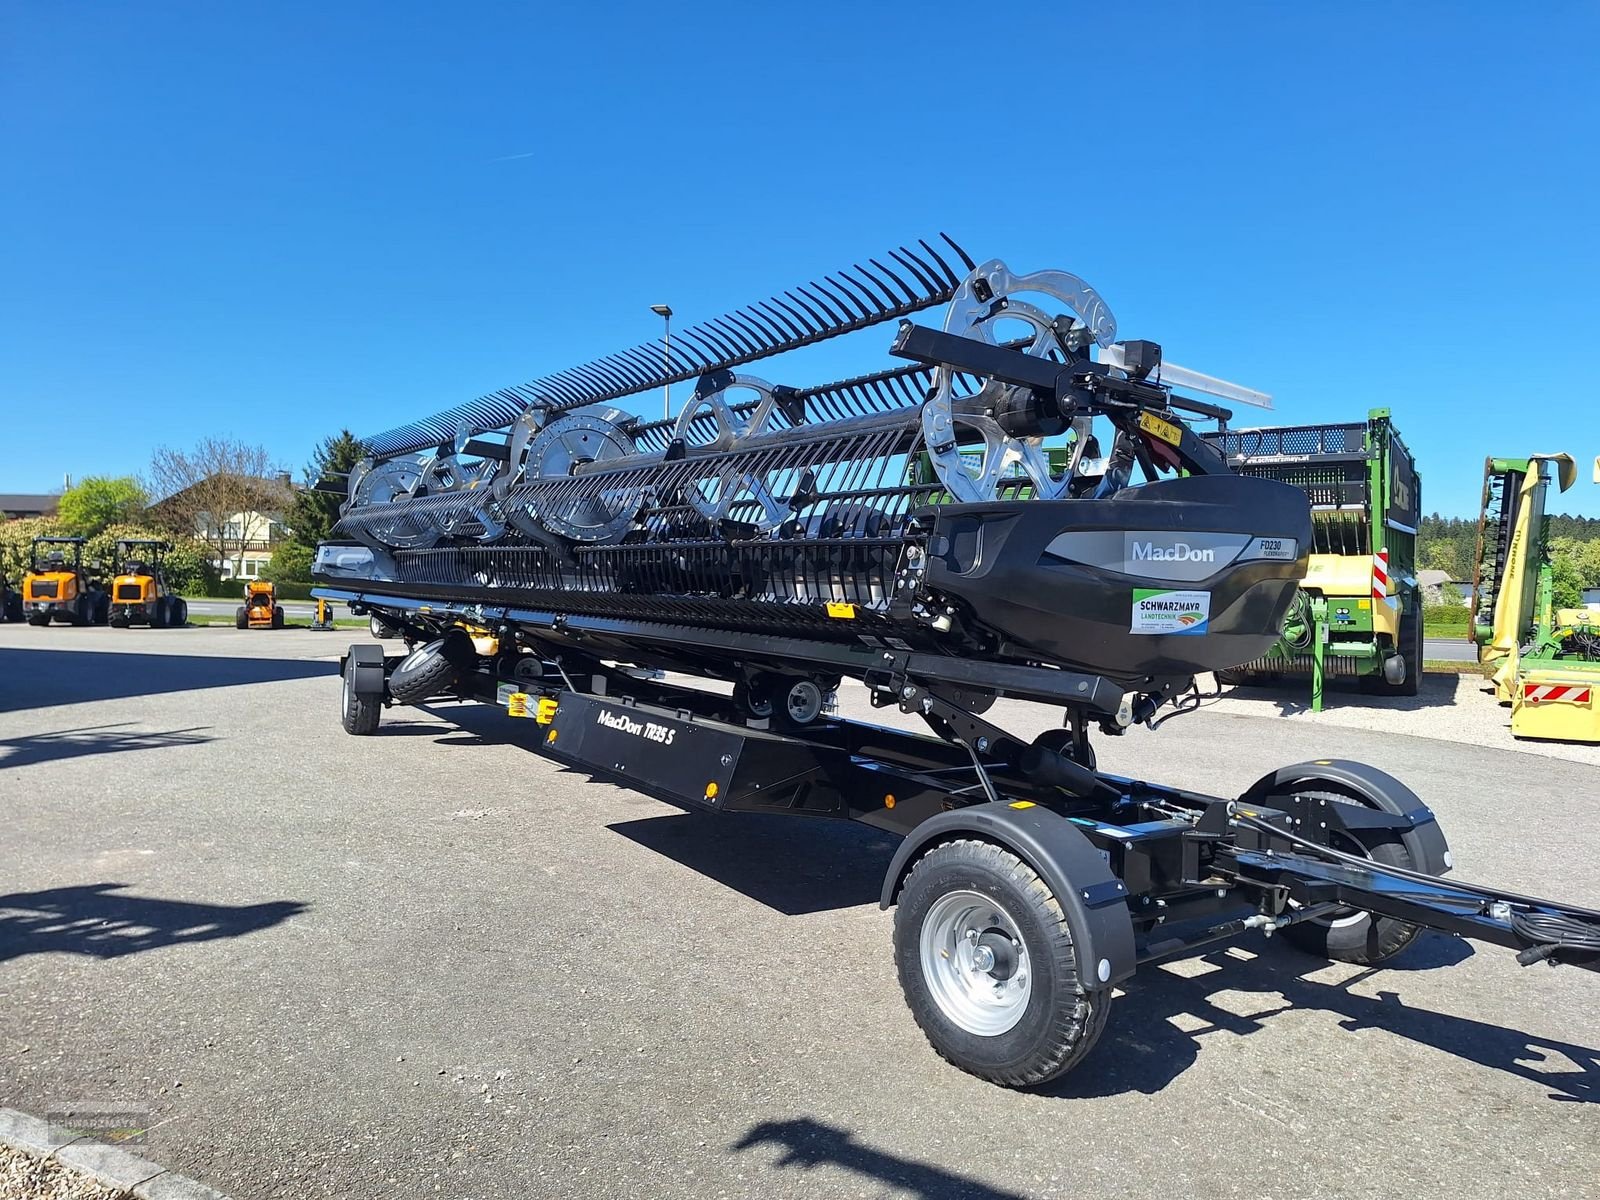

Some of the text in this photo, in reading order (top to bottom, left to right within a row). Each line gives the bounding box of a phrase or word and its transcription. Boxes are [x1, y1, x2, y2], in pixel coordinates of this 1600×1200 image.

[1260, 540, 1282, 550] FD230
[1132, 541, 1215, 562] MacDon
[1140, 601, 1201, 612] SCHWARZMAYR
[1140, 612, 1177, 621] LANDTECHNIK
[597, 709, 676, 745] MacDon TR35 S
